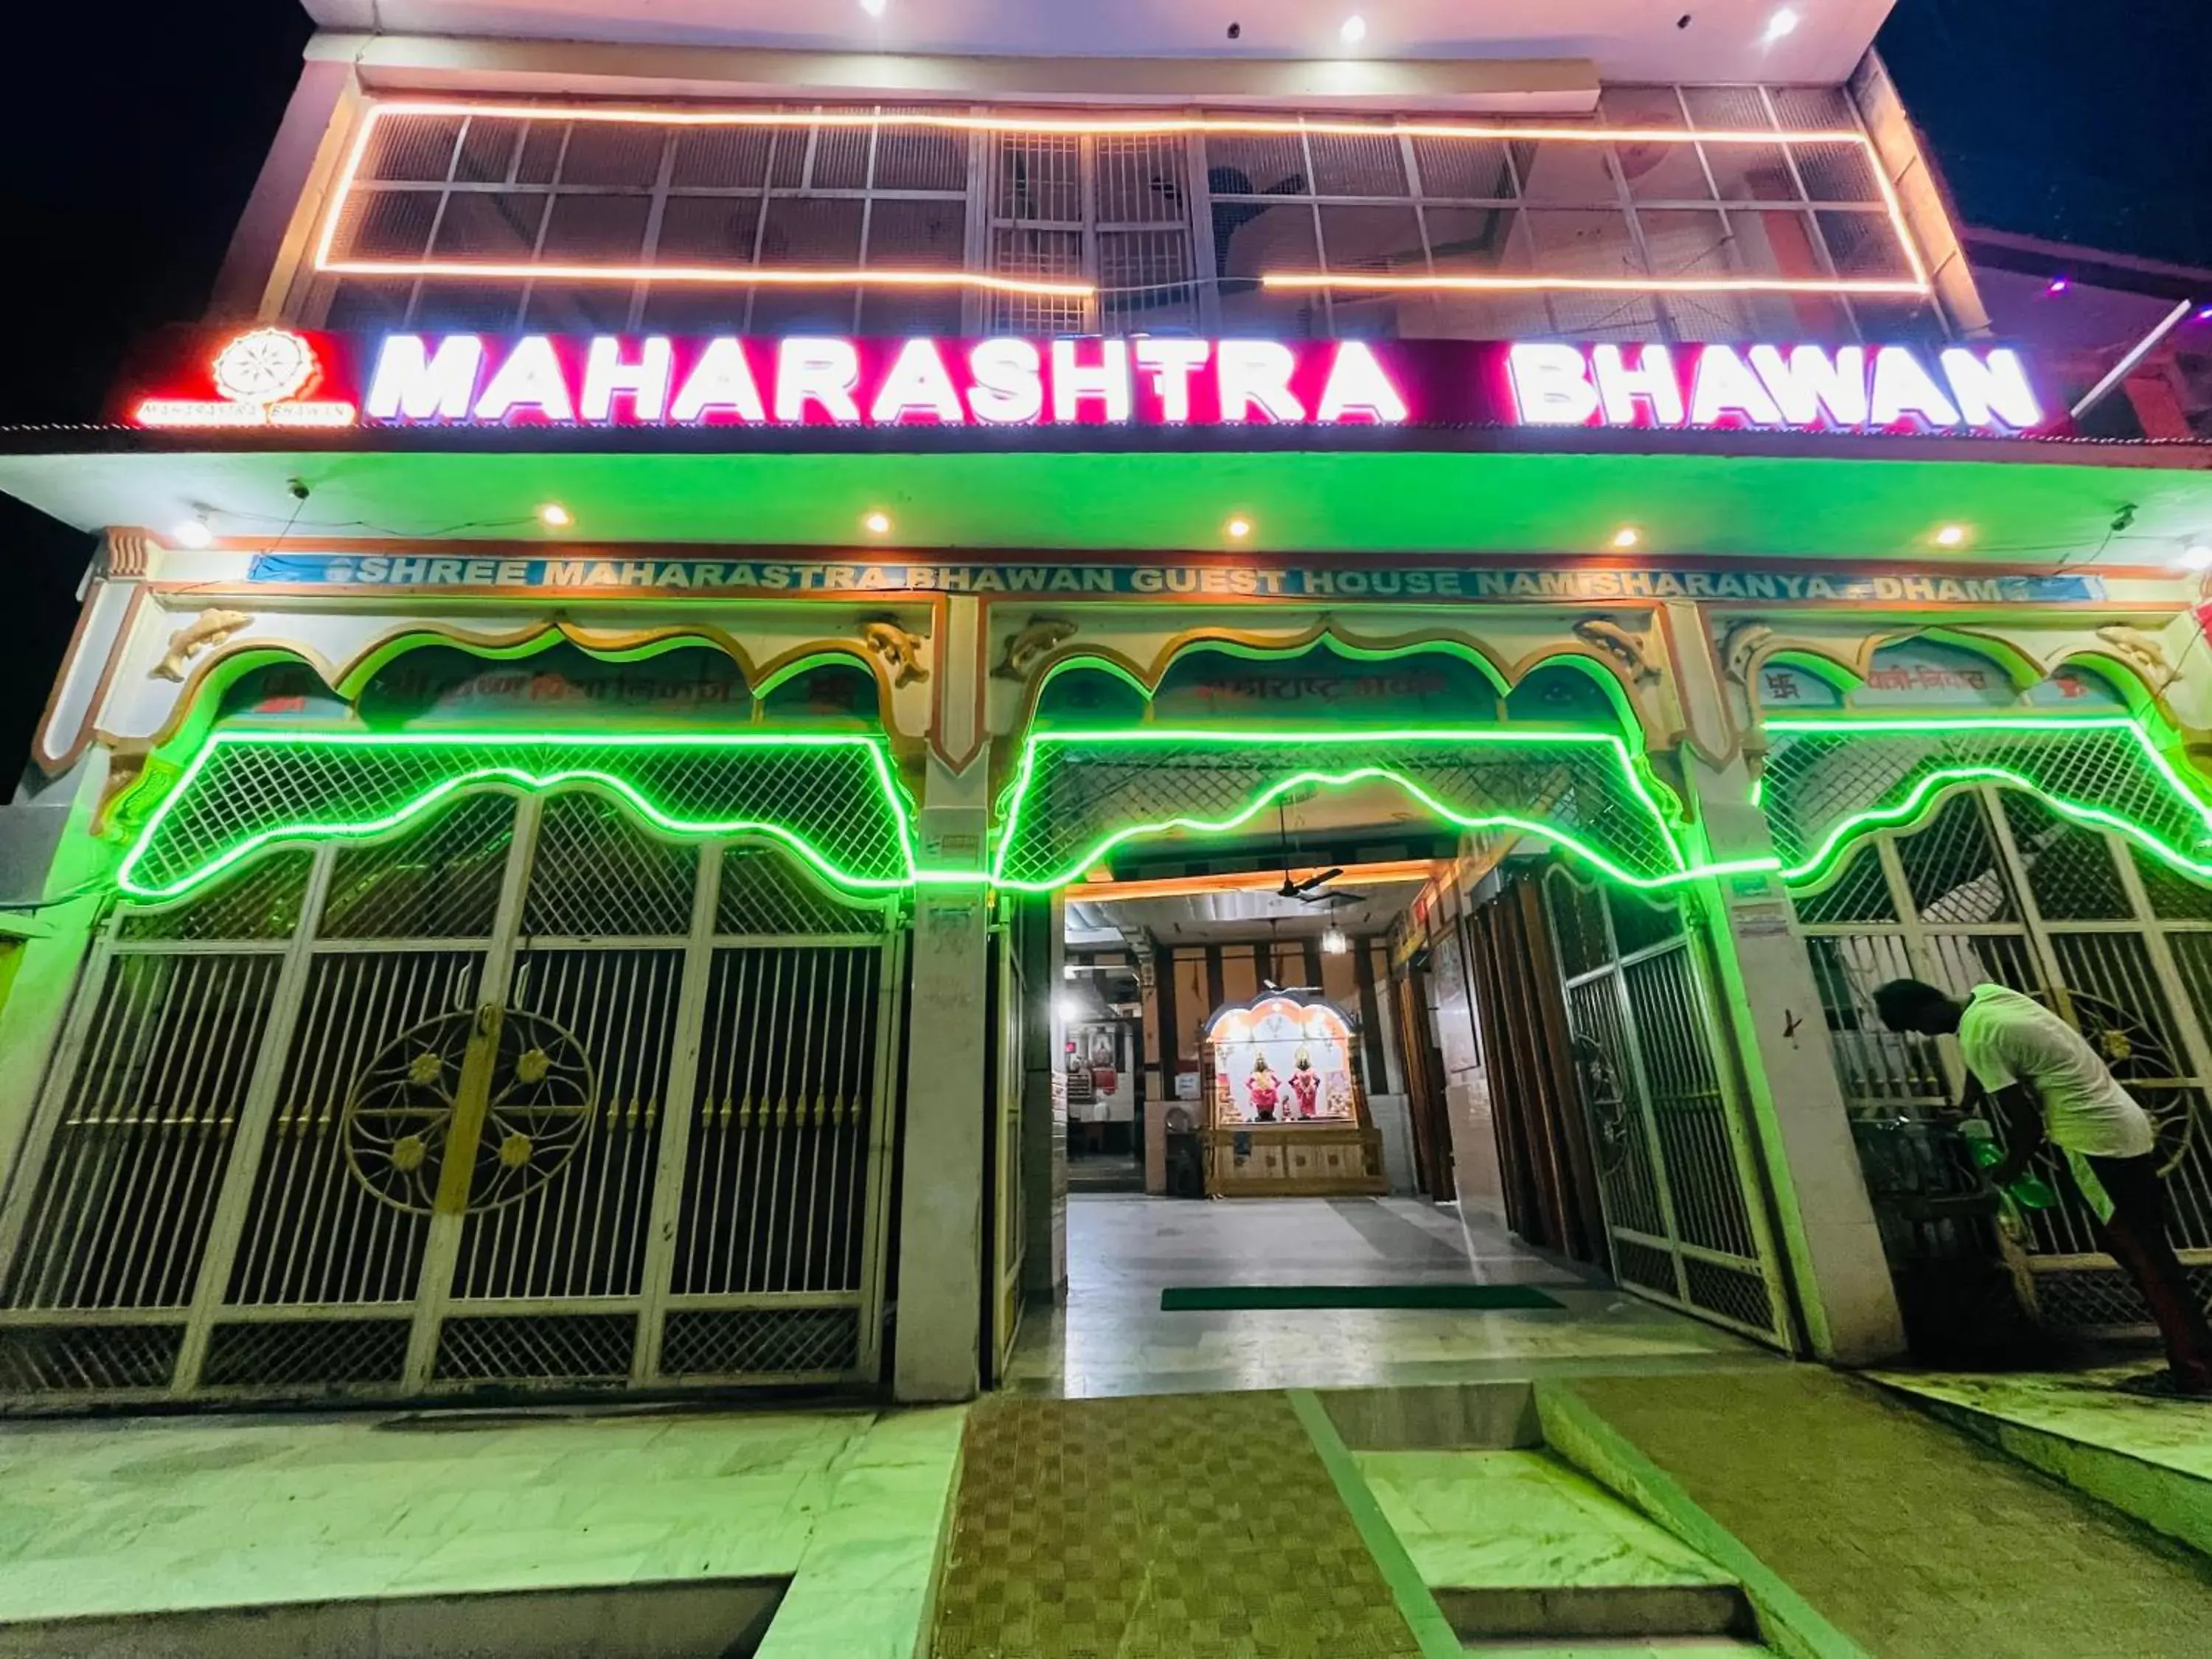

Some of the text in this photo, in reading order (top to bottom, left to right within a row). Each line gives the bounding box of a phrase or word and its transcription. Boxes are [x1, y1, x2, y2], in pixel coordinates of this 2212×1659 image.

[365, 334, 2043, 433] MAHARASHTRA BHAWAN
[356, 556, 527, 585] SHREE
[543, 560, 889, 590] MAHARASTRA
[905, 566, 1116, 592] BHAWAN
[1130, 568, 1288, 594] GUEST
[1304, 570, 1461, 595] HOUSE
